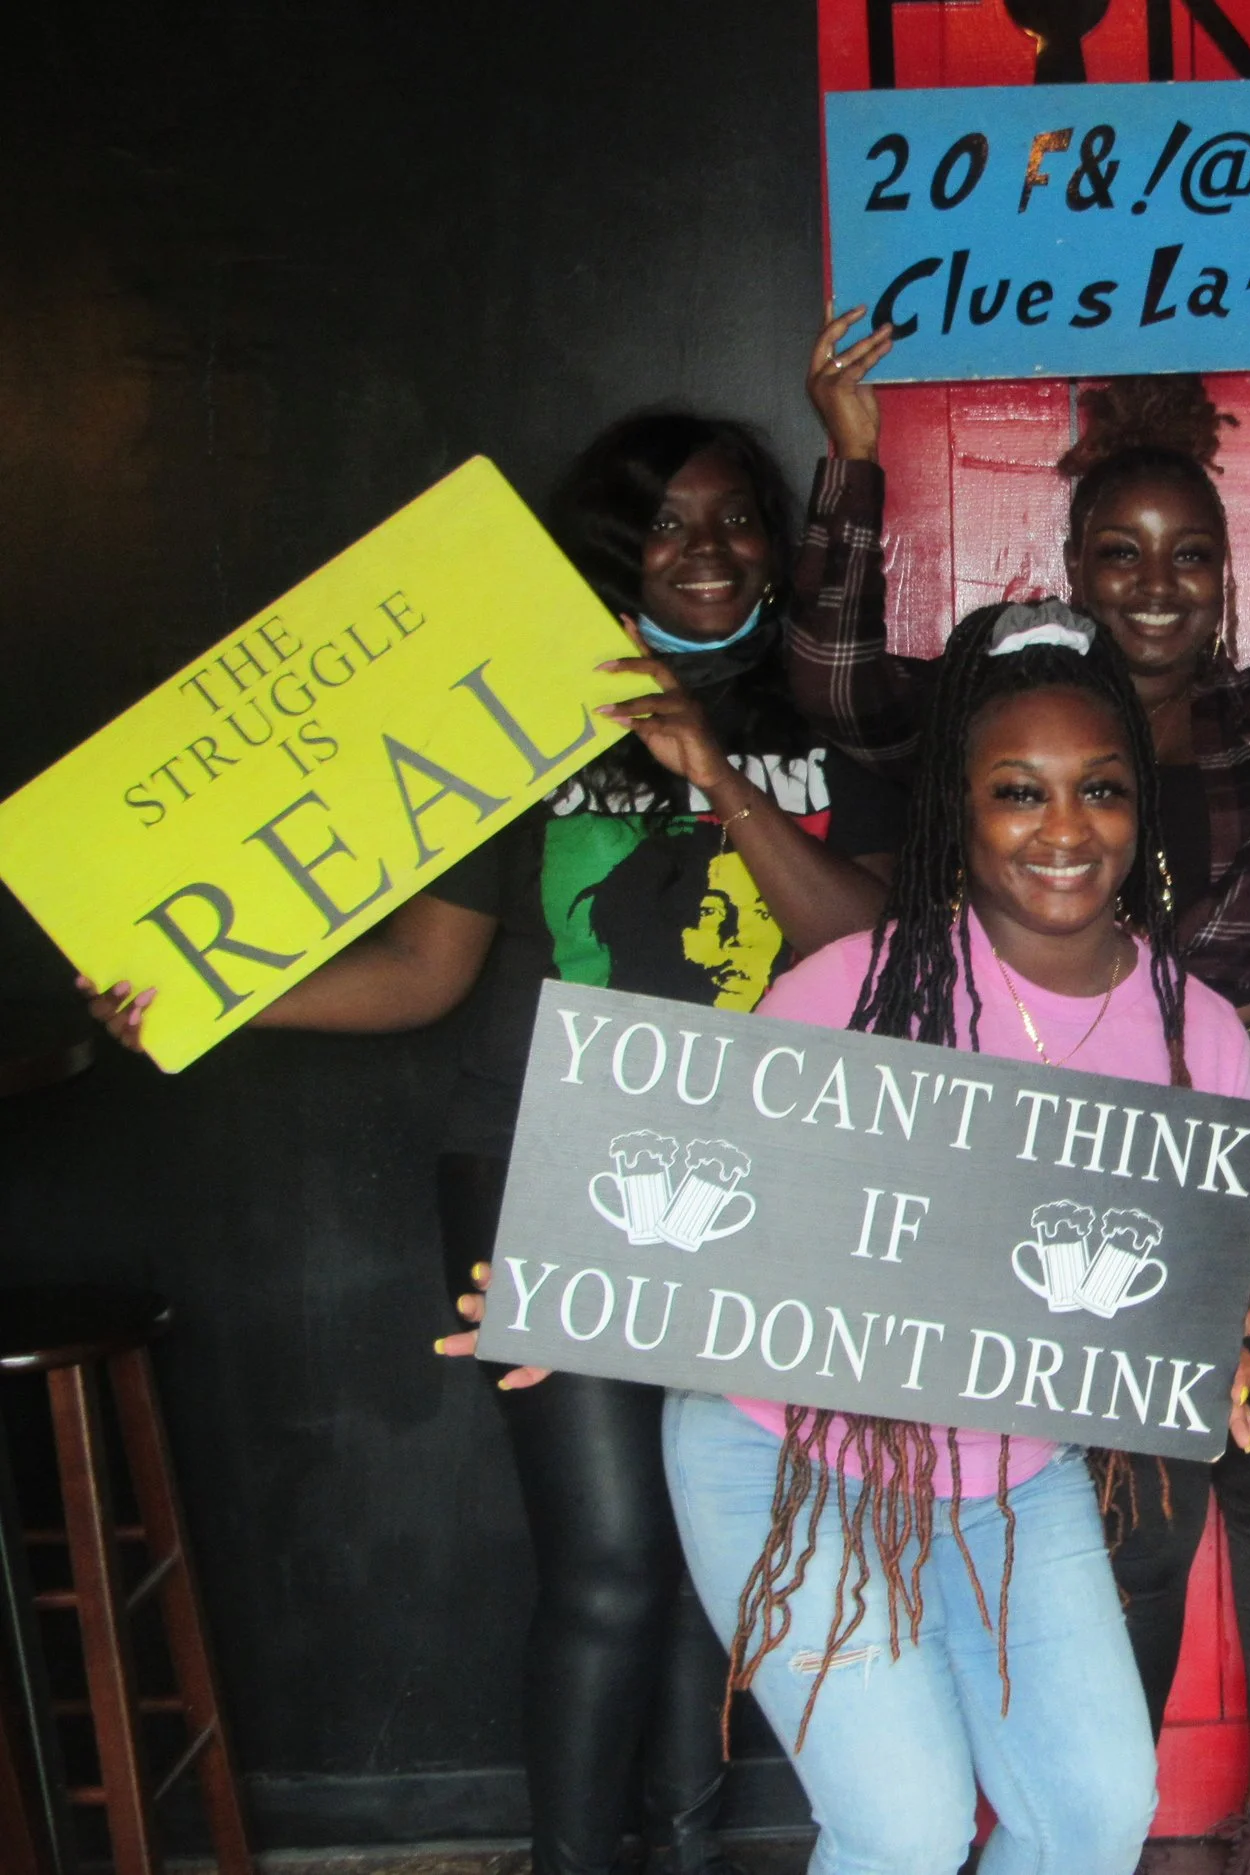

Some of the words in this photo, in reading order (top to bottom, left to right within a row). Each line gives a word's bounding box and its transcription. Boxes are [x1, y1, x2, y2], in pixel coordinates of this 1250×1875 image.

[865, 132, 989, 212] 20
[871, 248, 1118, 341] Clues
[124, 590, 427, 828] STRUGGLE
[179, 615, 303, 716] THE
[278, 719, 339, 779] IS
[133, 658, 597, 1022] REAL
[557, 1009, 735, 1106] YOU
[752, 1046, 994, 1150] CAN'T
[850, 1187, 932, 1264] IF
[503, 1257, 682, 1351] YOU
[696, 1287, 945, 1391] DON'T
[959, 1328, 1216, 1434] DRINK
